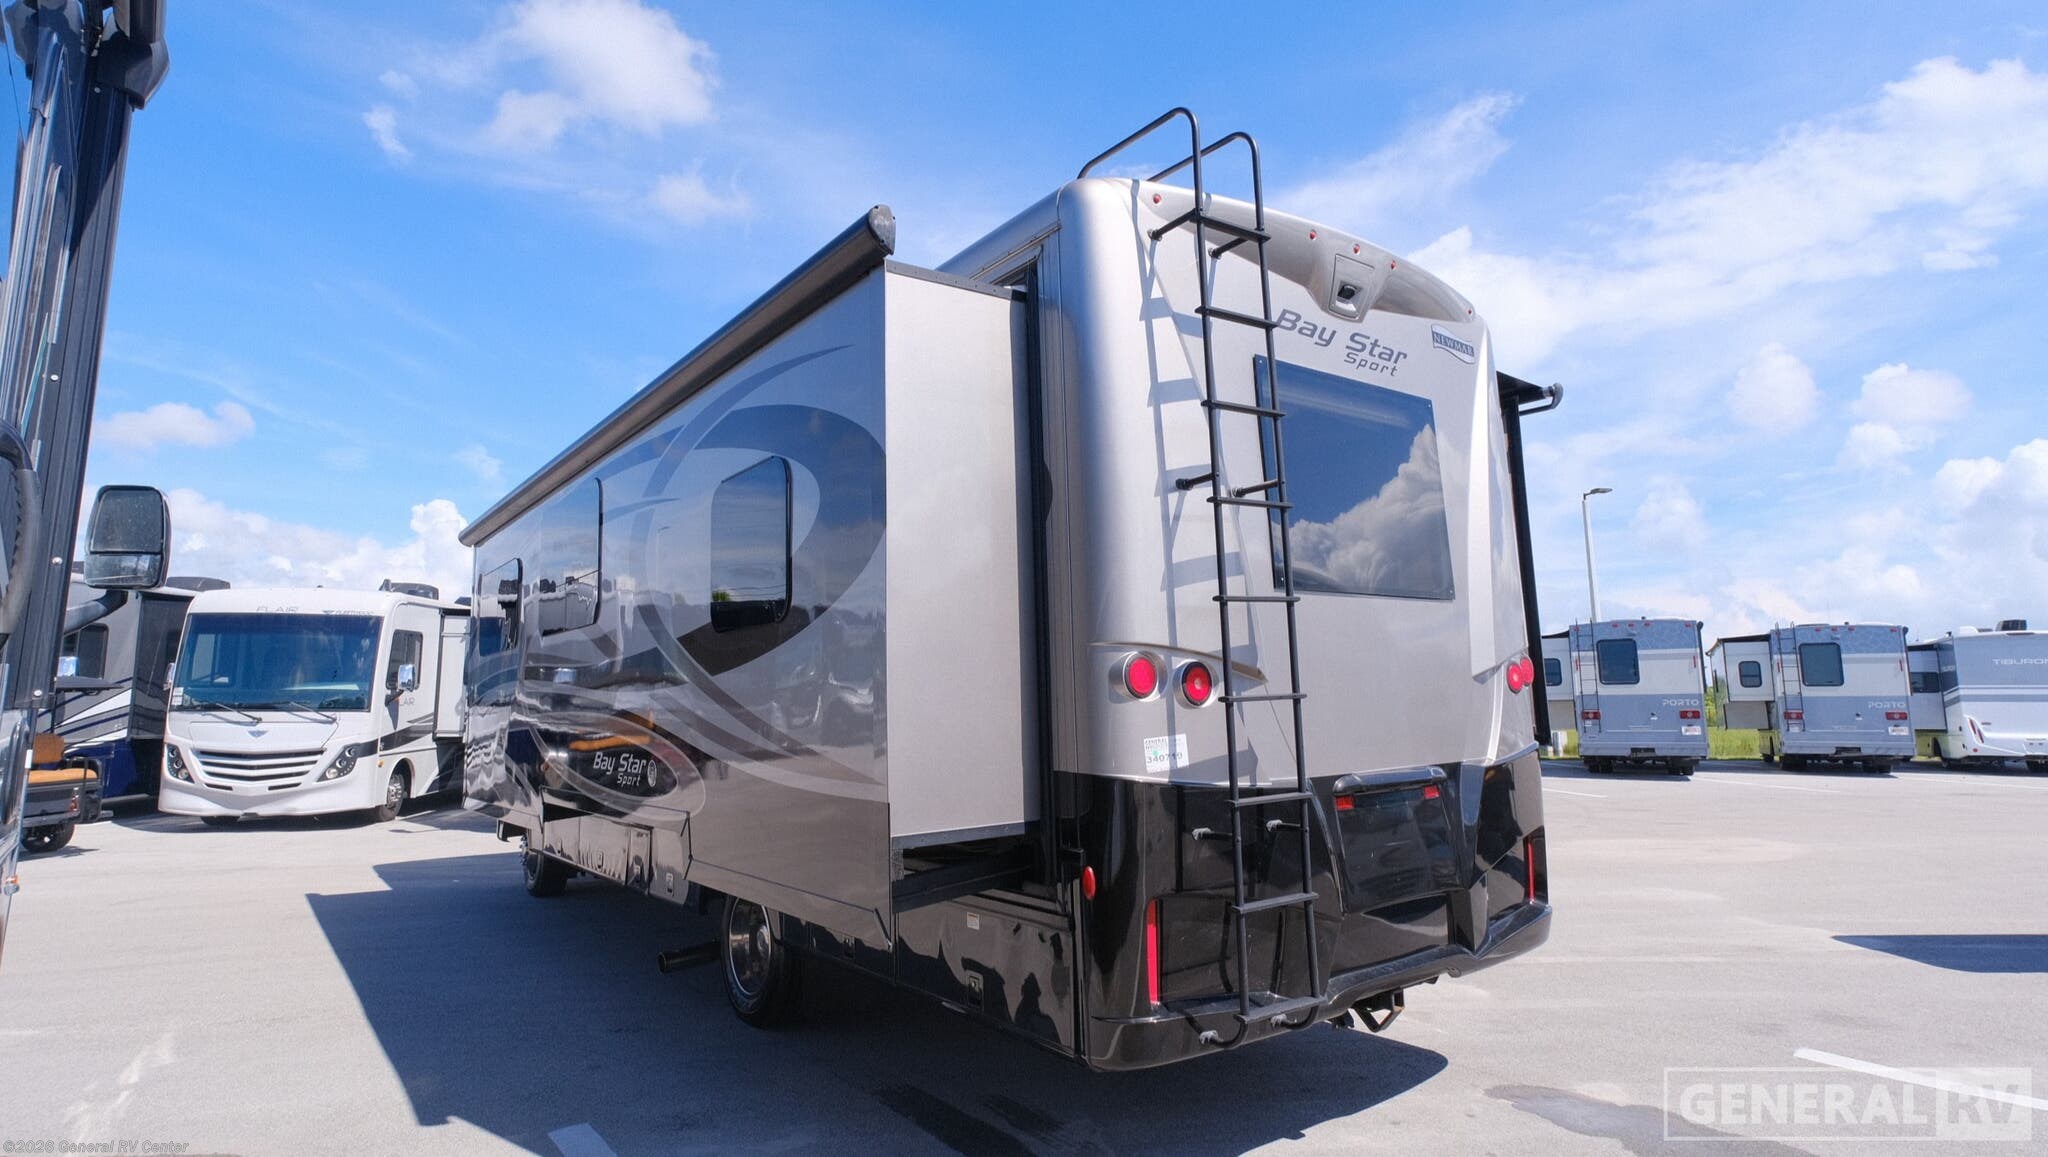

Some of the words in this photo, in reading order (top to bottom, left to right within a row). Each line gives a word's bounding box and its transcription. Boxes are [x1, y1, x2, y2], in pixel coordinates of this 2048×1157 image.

[1277, 308, 1337, 347] Bay
[1345, 332, 1408, 364] Star
[1433, 331, 1474, 356] NEWMAR
[1343, 352, 1400, 377] Sport
[1867, 701, 1906, 709] PORTO
[593, 751, 616, 775] Bay
[618, 753, 647, 774] Star
[617, 773, 641, 787] Sport
